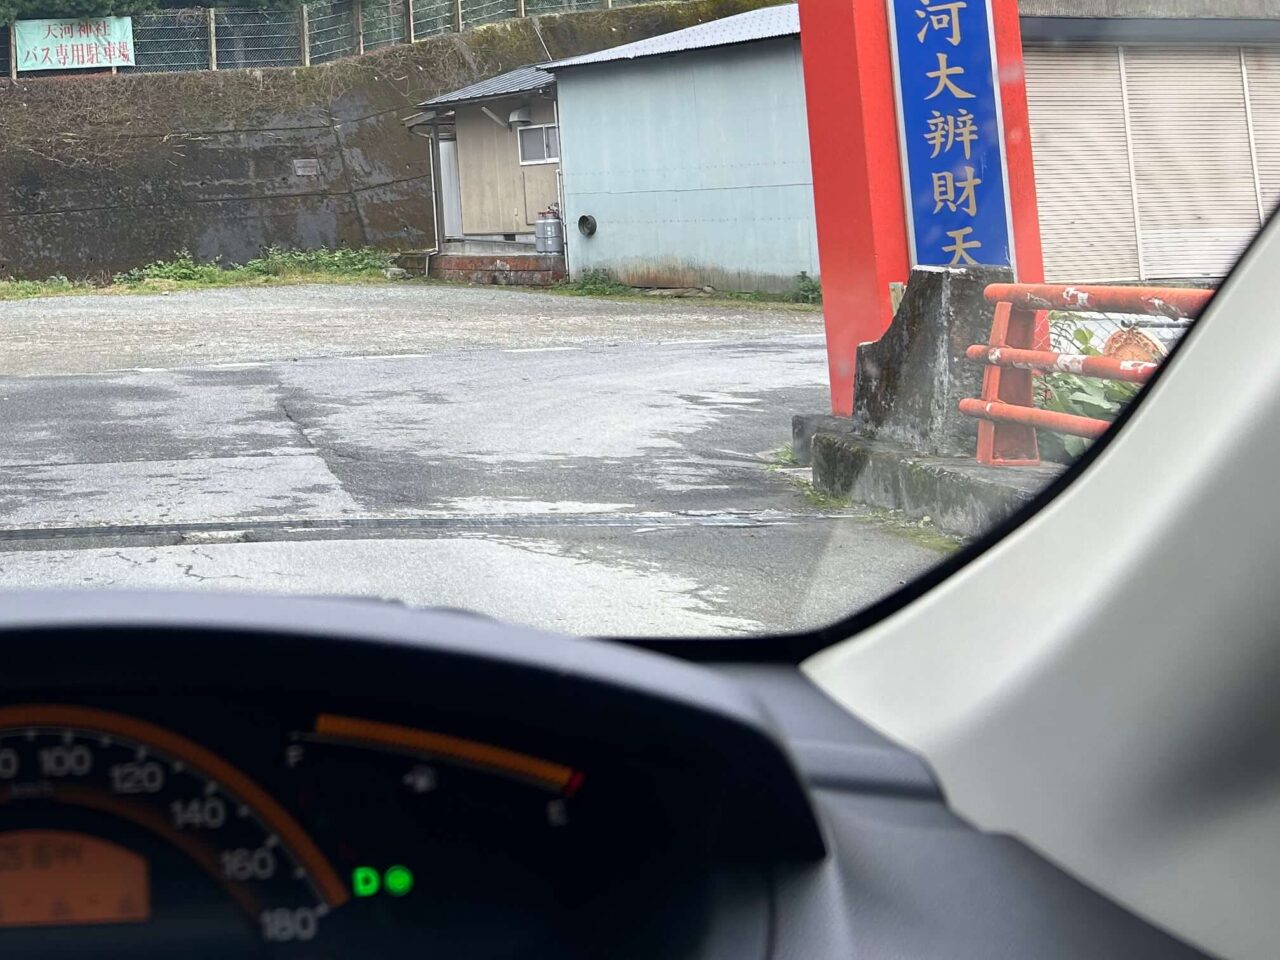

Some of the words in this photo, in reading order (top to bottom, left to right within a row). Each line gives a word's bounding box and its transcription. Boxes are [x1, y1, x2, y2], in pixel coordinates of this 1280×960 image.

[43, 21, 111, 39] 天河神社
[39, 745, 91, 777] 100
[109, 762, 164, 793] 120
[171, 798, 226, 829] 140
[222, 848, 276, 879] 160
[261, 908, 317, 942] 180
[352, 866, 381, 897] D
